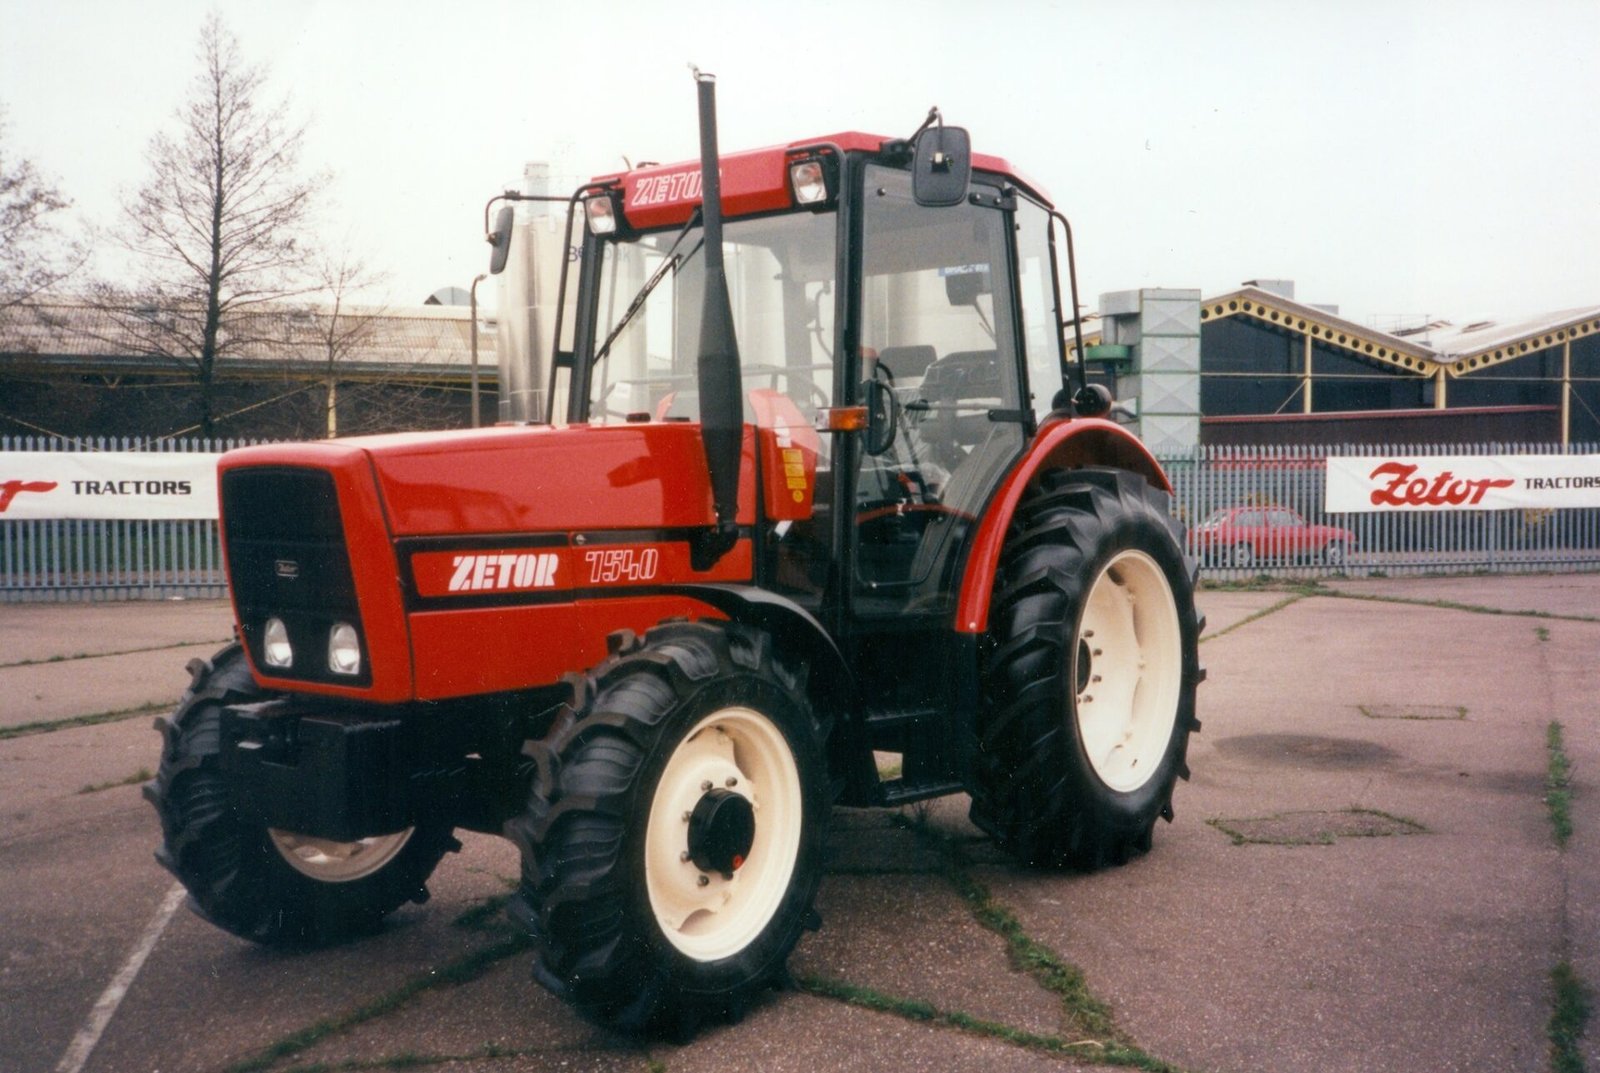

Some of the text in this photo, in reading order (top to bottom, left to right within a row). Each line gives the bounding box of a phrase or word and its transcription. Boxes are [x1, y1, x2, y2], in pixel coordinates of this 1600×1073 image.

[631, 168, 722, 206] ZETO
[71, 480, 191, 495] TRACTORS
[1369, 462, 1515, 506] Zetor
[449, 549, 658, 591] ZETOR 7540
